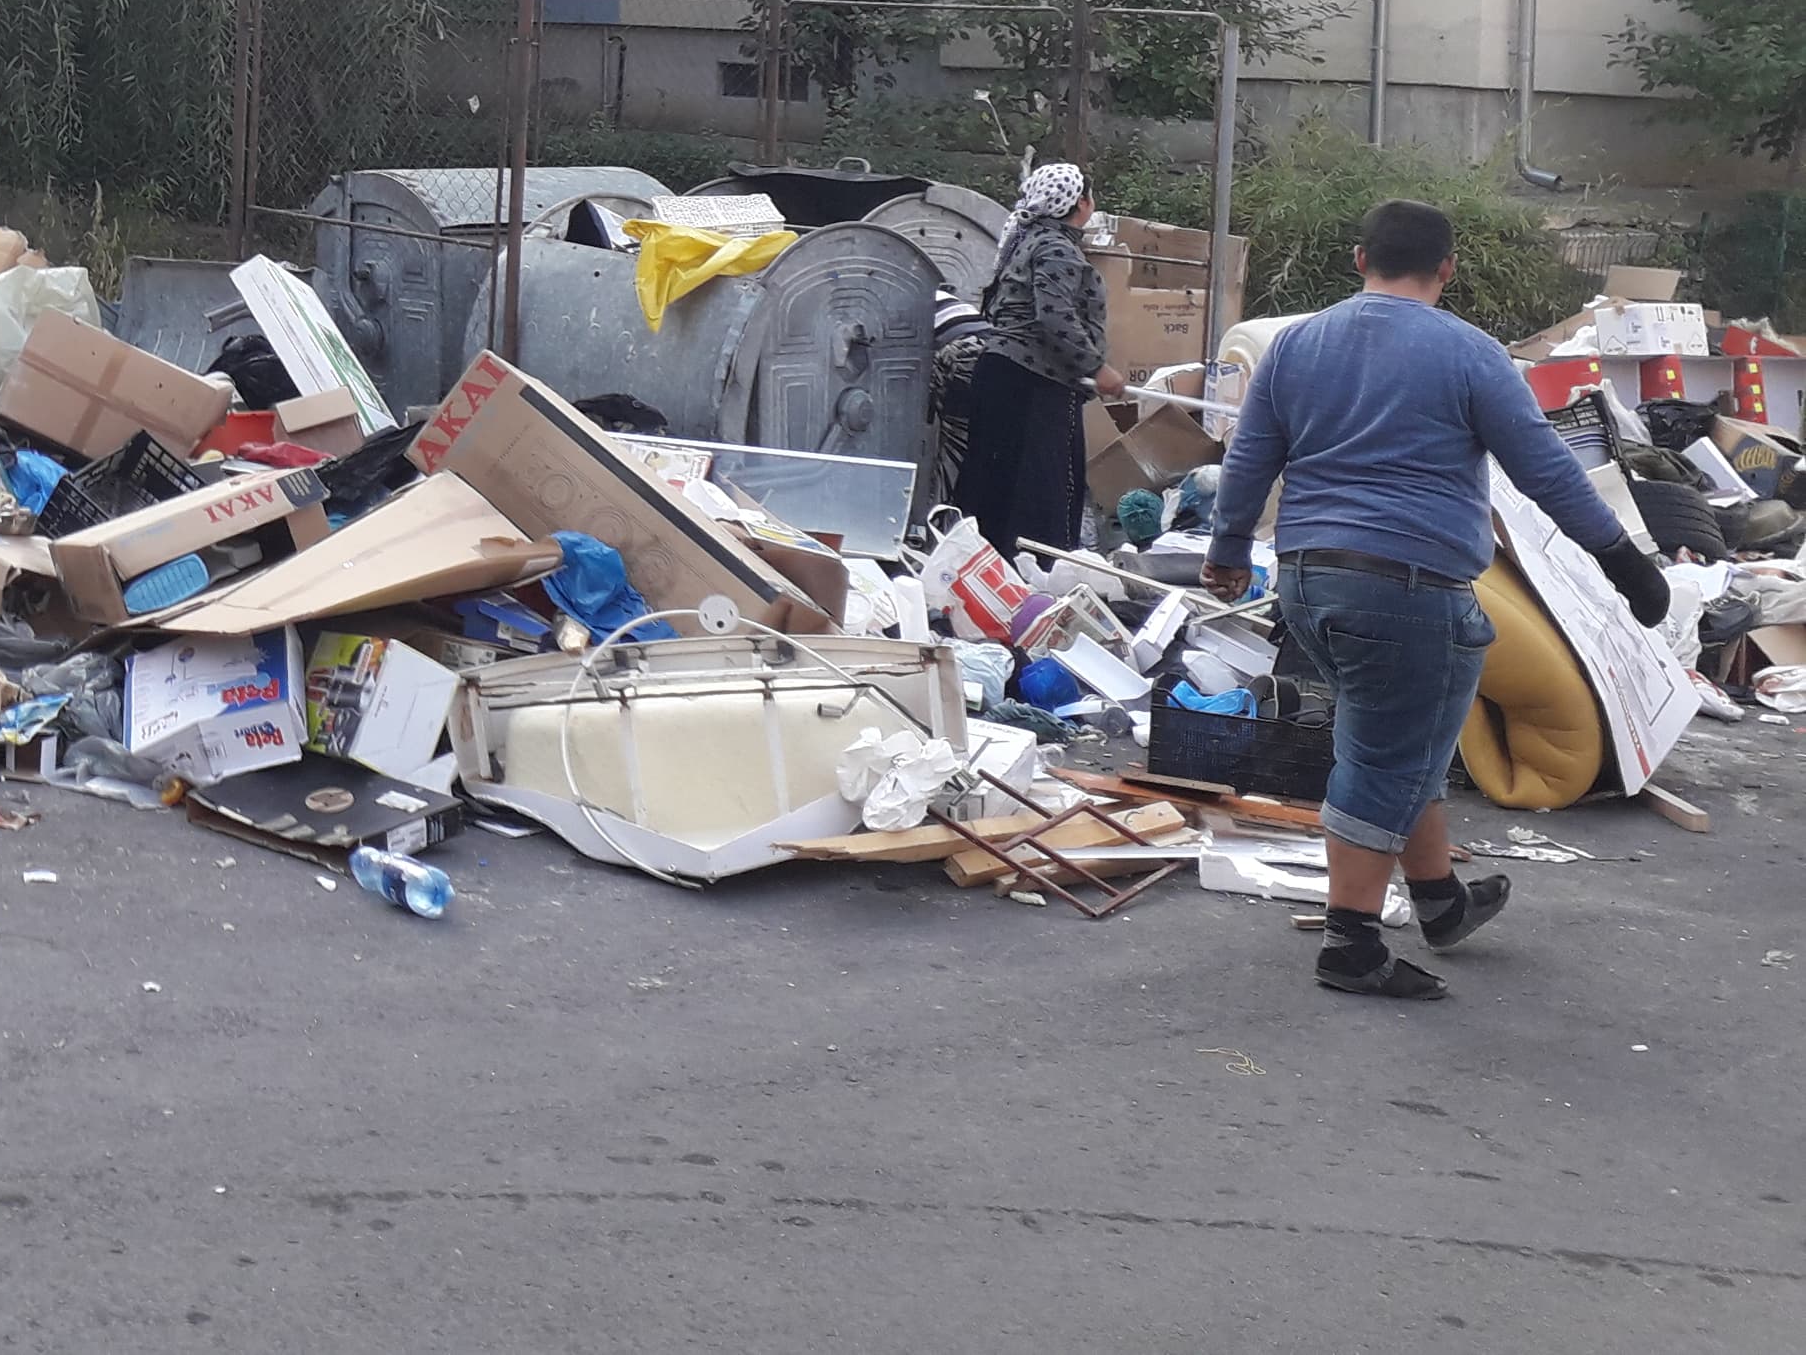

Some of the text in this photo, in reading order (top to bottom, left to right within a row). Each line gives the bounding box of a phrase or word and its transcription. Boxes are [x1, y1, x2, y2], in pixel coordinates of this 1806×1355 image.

[1163, 322, 1189, 334] Back
[417, 356, 509, 473] AKAI
[204, 485, 276, 524] AKAI
